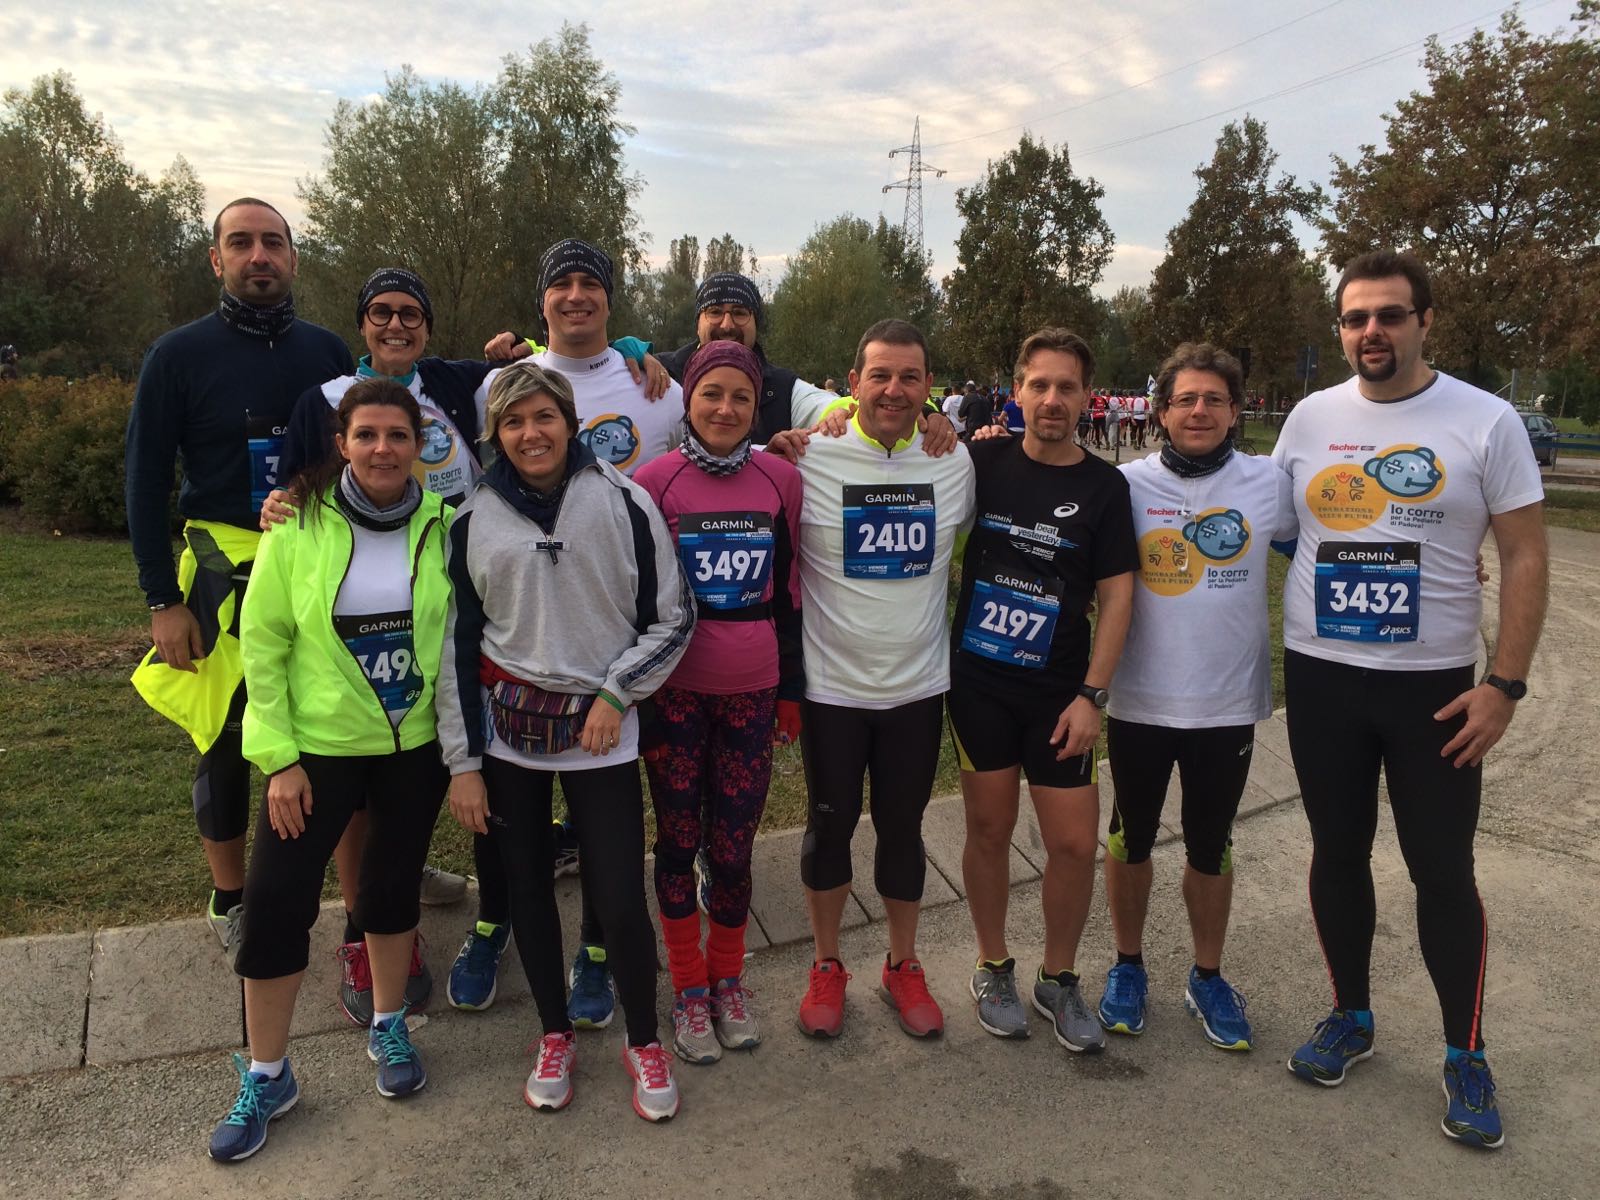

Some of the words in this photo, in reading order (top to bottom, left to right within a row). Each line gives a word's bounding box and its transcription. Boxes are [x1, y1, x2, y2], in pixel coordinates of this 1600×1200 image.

[1328, 443, 1360, 452] fischer
[440, 467, 462, 480] corro
[865, 493, 915, 503] GARMIN
[984, 512, 1013, 524] GARMIN
[1147, 508, 1176, 516] fischer
[1407, 507, 1445, 519] corro
[701, 520, 753, 530] GARMIN
[1036, 523, 1057, 535] beat
[858, 522, 926, 552] 2410
[1338, 551, 1395, 561] GARMIN
[695, 549, 768, 582] 3497
[1220, 569, 1249, 578] corro
[994, 574, 1044, 594] GARMIN
[1329, 581, 1410, 614] 3432
[359, 619, 413, 633] GARMIN
[978, 601, 1048, 641] 2197
[1390, 626, 1412, 634] asics
